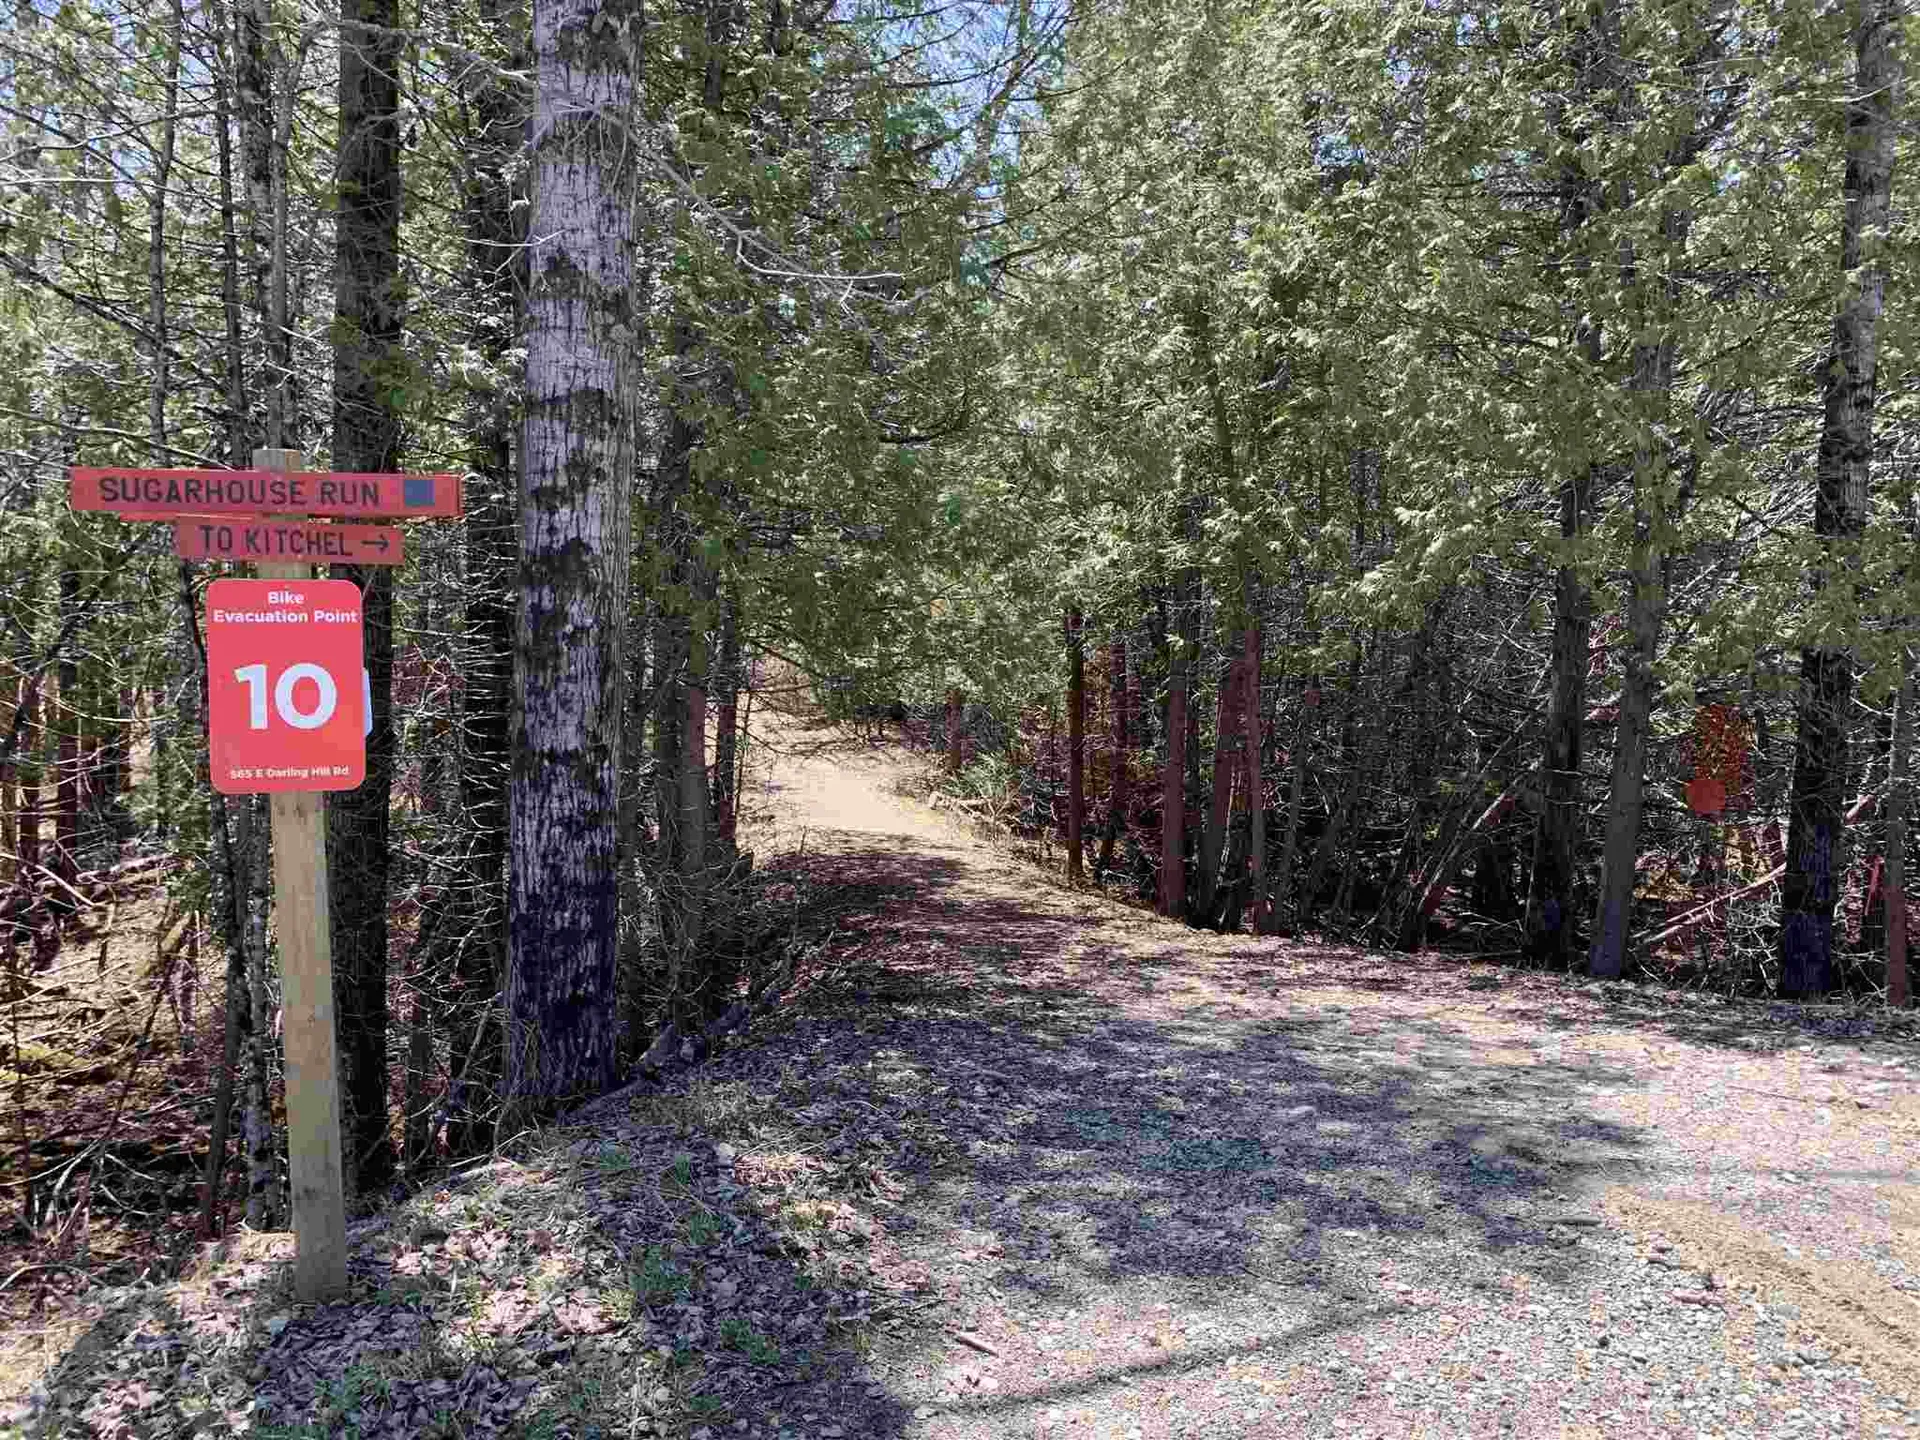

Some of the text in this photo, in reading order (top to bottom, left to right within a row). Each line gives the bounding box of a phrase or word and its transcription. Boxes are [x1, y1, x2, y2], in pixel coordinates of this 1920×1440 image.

[99, 477, 380, 506] SUGARHOUSE RUN
[199, 525, 353, 557] TO KITCHEL
[268, 591, 305, 604] Bike
[213, 609, 358, 623] Evacuation Point
[234, 662, 337, 730] 10
[256, 768, 263, 778] E
[267, 767, 309, 779] Darling
[311, 766, 331, 776] Hill
[333, 765, 349, 775] Rd
